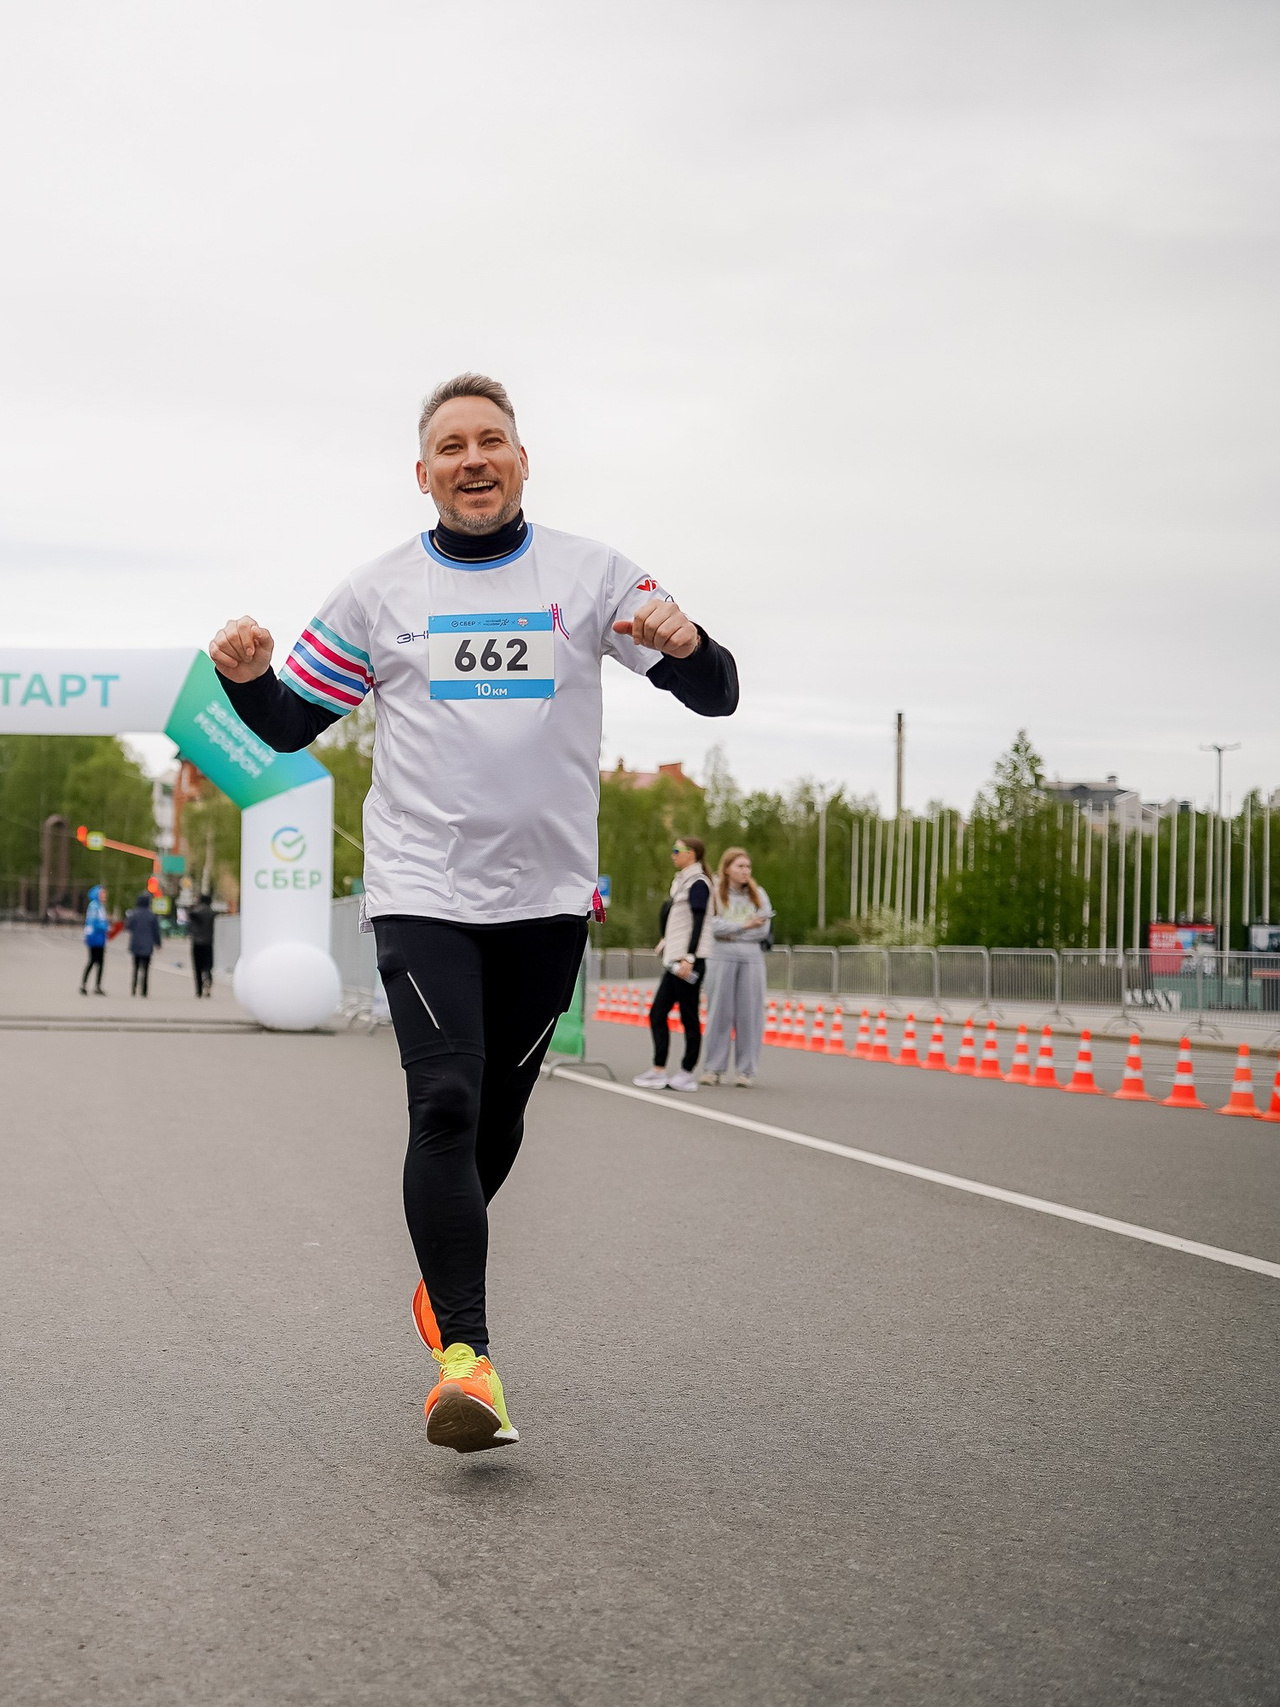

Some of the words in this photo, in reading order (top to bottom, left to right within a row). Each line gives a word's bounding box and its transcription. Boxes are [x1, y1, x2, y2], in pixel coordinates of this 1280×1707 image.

[454, 638, 529, 673] 662
[474, 682, 492, 697] 10
[193, 712, 262, 779] марафон
[254, 868, 322, 891] СБЕР
